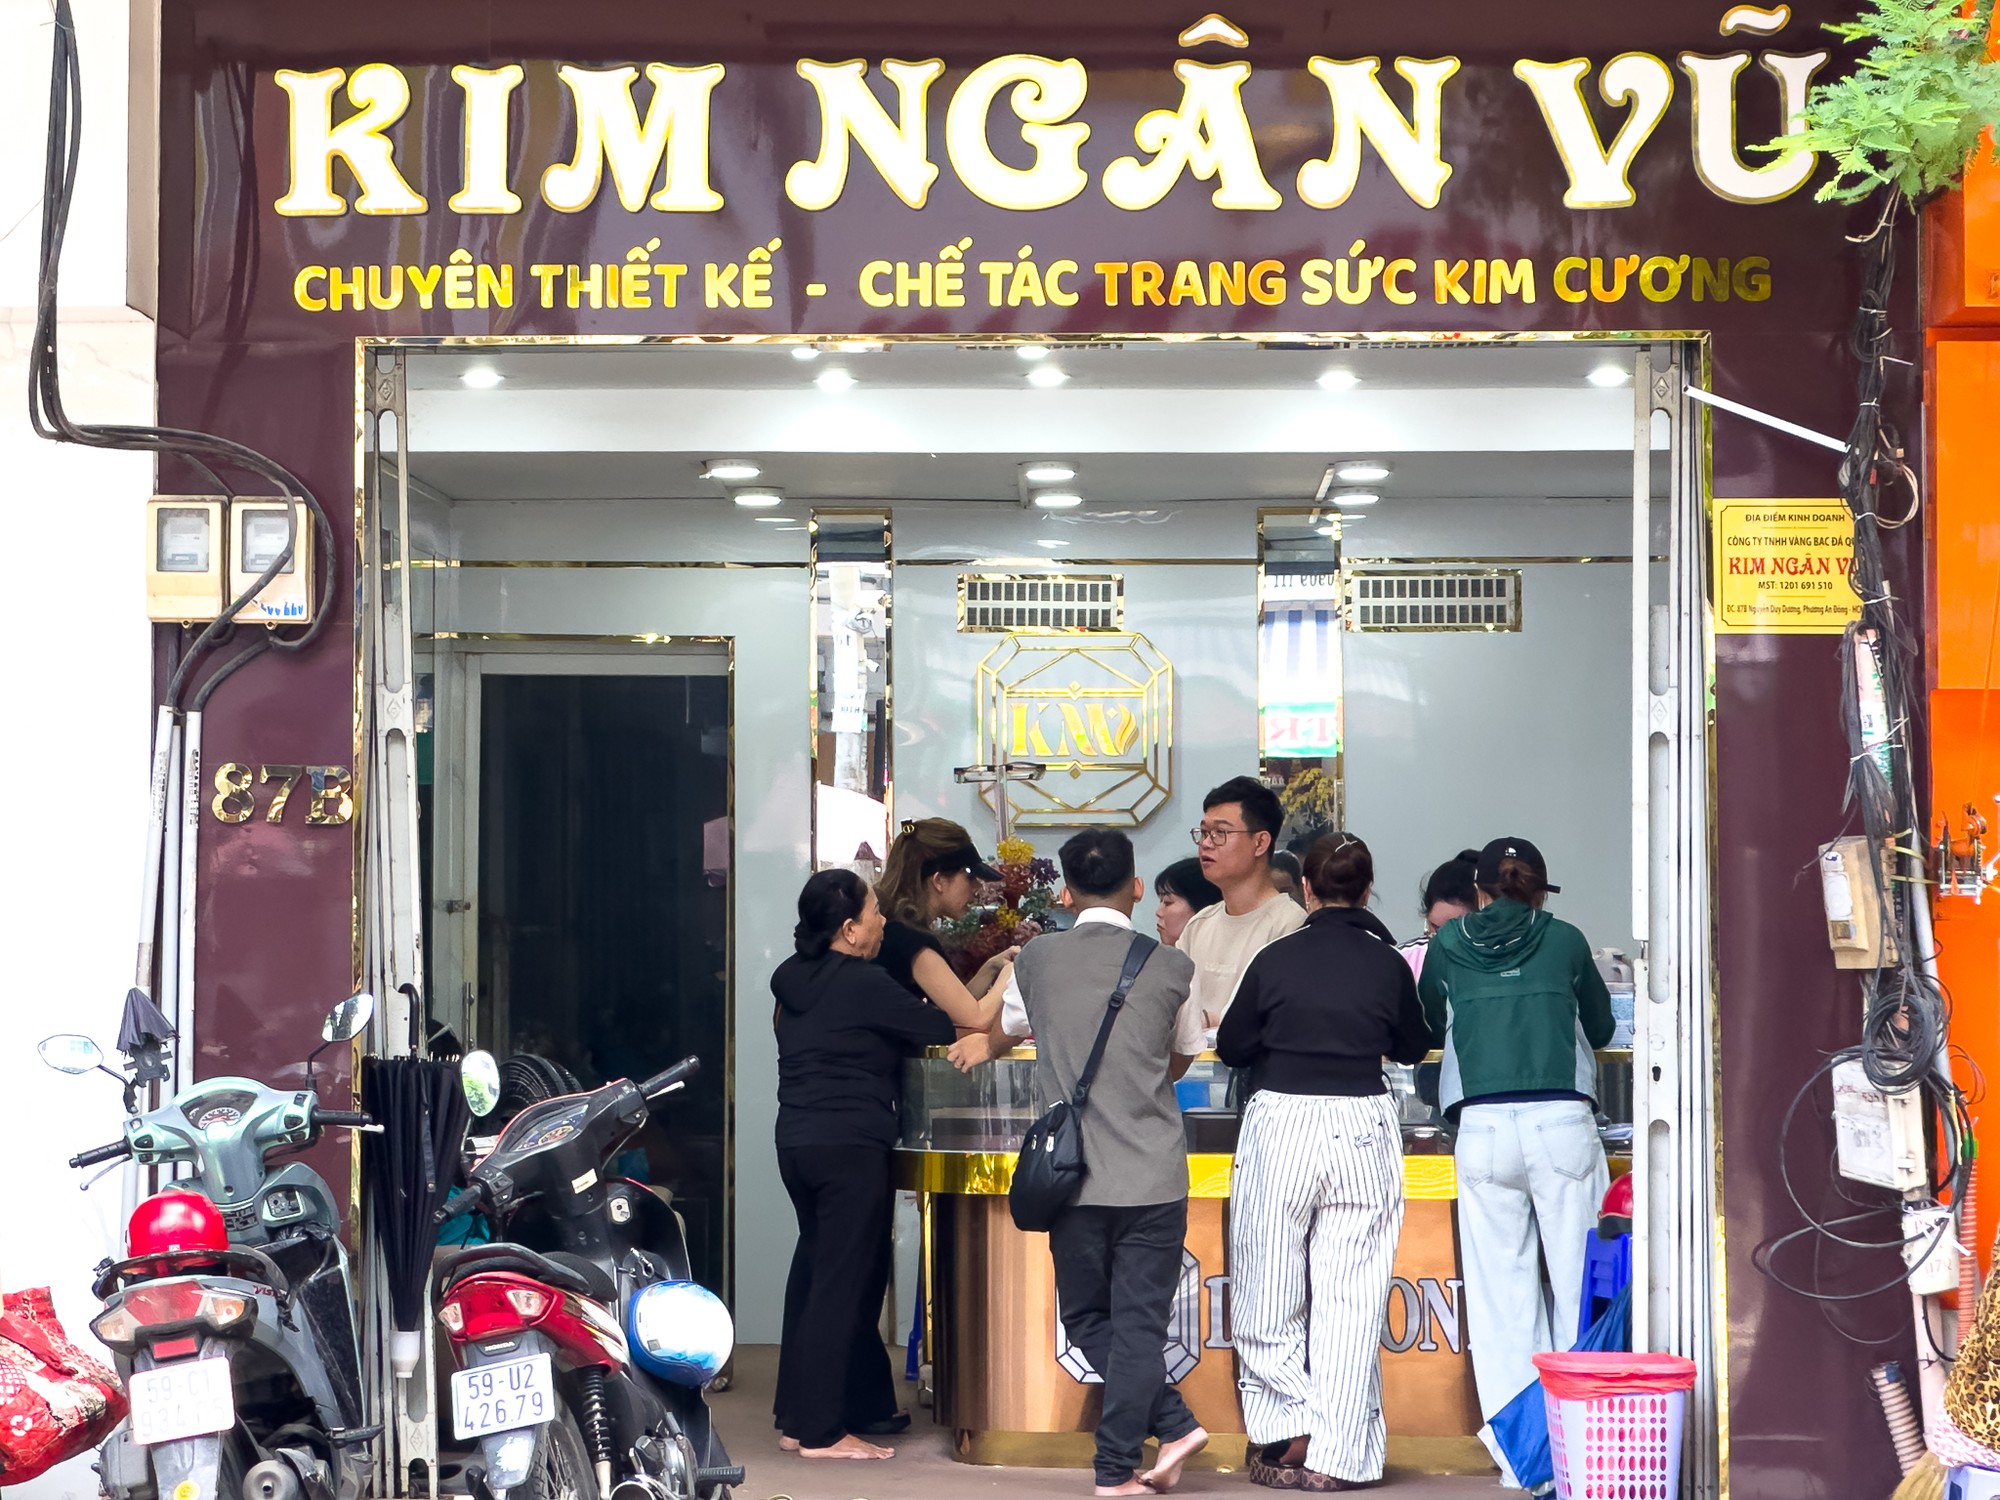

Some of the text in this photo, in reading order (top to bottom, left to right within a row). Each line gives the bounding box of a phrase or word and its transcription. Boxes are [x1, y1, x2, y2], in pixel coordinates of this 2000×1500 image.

[274, 4, 1830, 216] KIM NGÂN VŨ
[294, 236, 1773, 312] CHUYÊN THIẾT KẾ - CHẾ TÁC TRANG SỨC KIM CƯƠNG
[1788, 514, 1810, 522] KINH
[1812, 514, 1845, 522] DOANH
[1753, 537, 1762, 546] TY
[1764, 537, 1787, 546] TNHH
[1788, 535, 1812, 546] VÀNG
[1729, 557, 1765, 575] KIM
[1770, 553, 1830, 575] NGÂN
[1758, 581, 1833, 590] MST: 1201 691 510
[211, 762, 354, 825] 87B
[484, 1341, 516, 1352] HONDA
[468, 1364, 535, 1400] 59-U2
